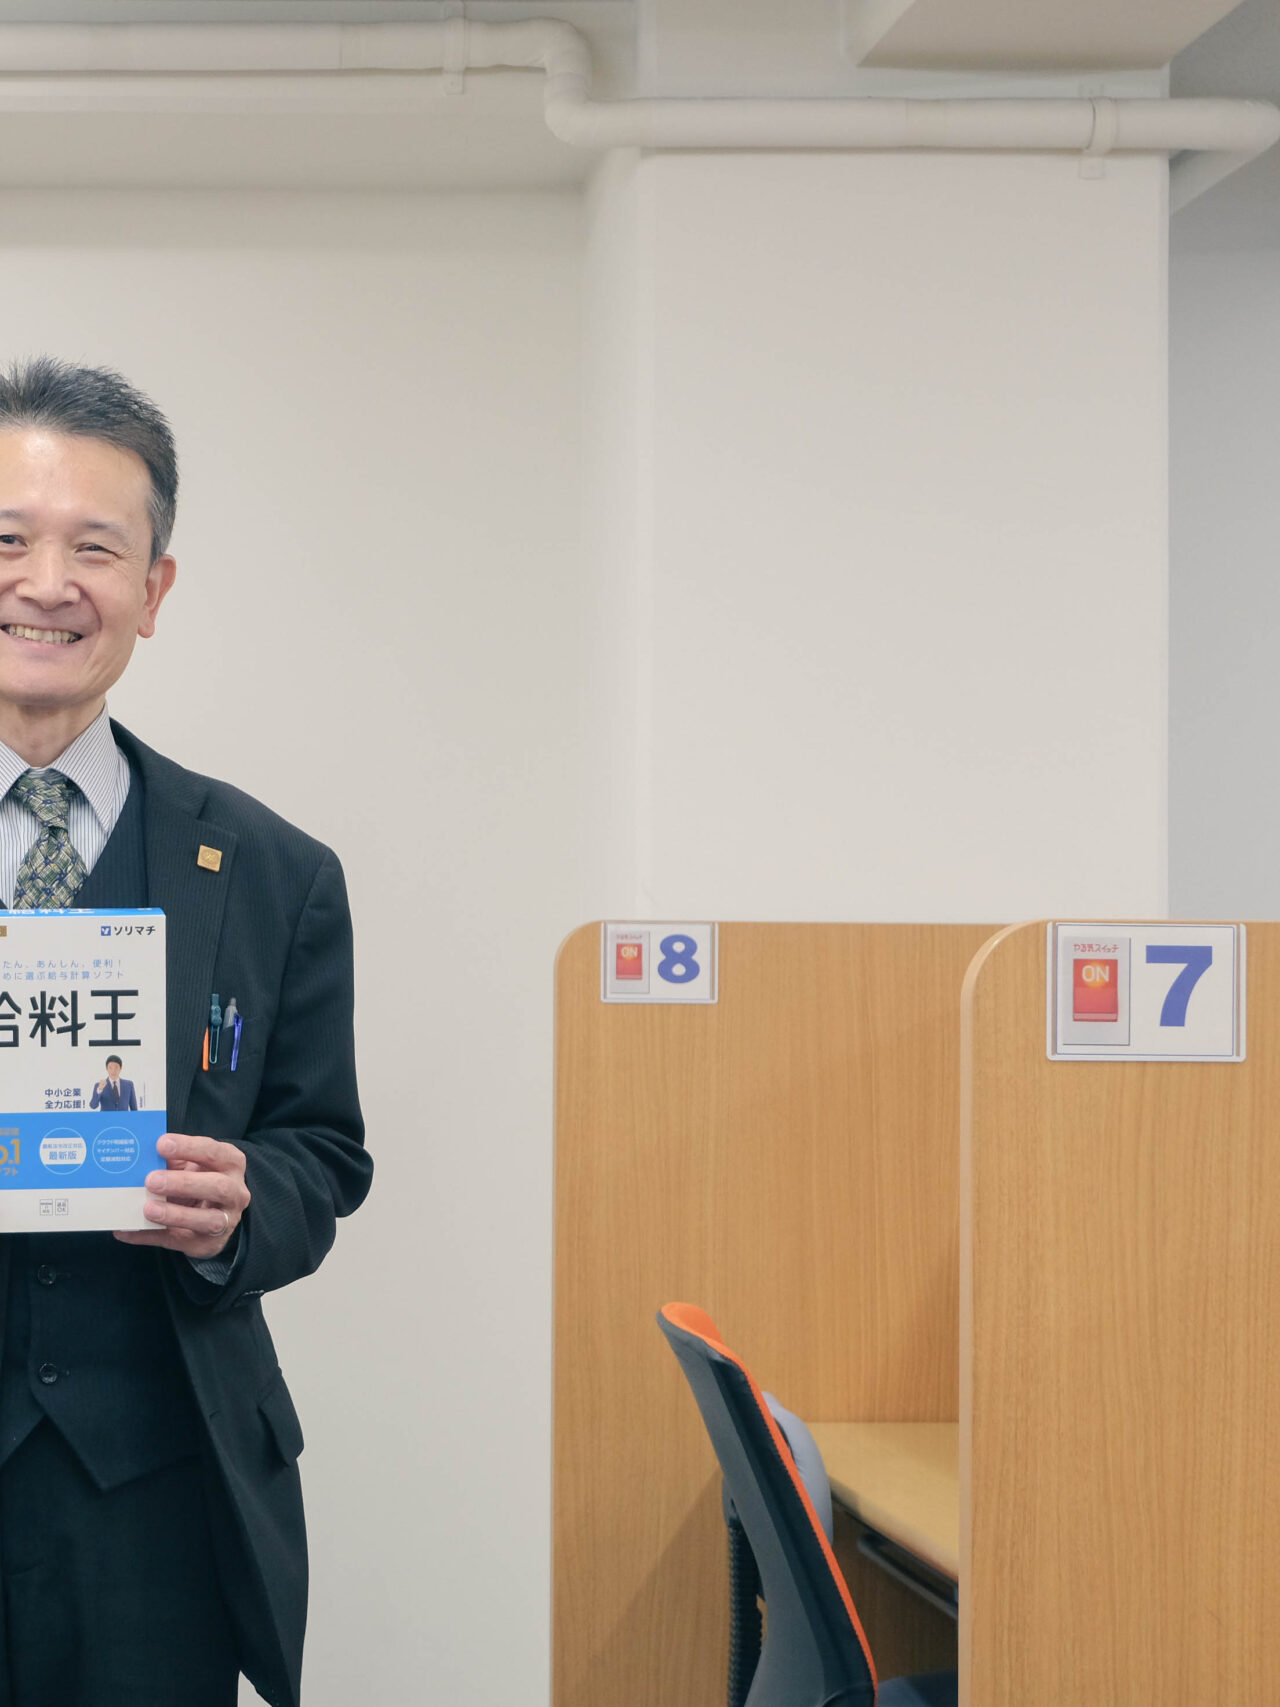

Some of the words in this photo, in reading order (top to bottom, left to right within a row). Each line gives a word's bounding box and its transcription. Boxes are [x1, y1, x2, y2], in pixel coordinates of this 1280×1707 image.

[113, 925, 156, 936] ソリマチ
[620, 945, 639, 958] ON
[1073, 943, 1120, 953] やる気スイッチ
[657, 933, 701, 984] 8
[1081, 964, 1110, 983] ON
[1145, 944, 1213, 1027] 7
[44, 1088, 82, 1097] 中小企業
[44, 1099, 86, 1110] 全力応援!
[49, 1150, 78, 1161] 最新版
